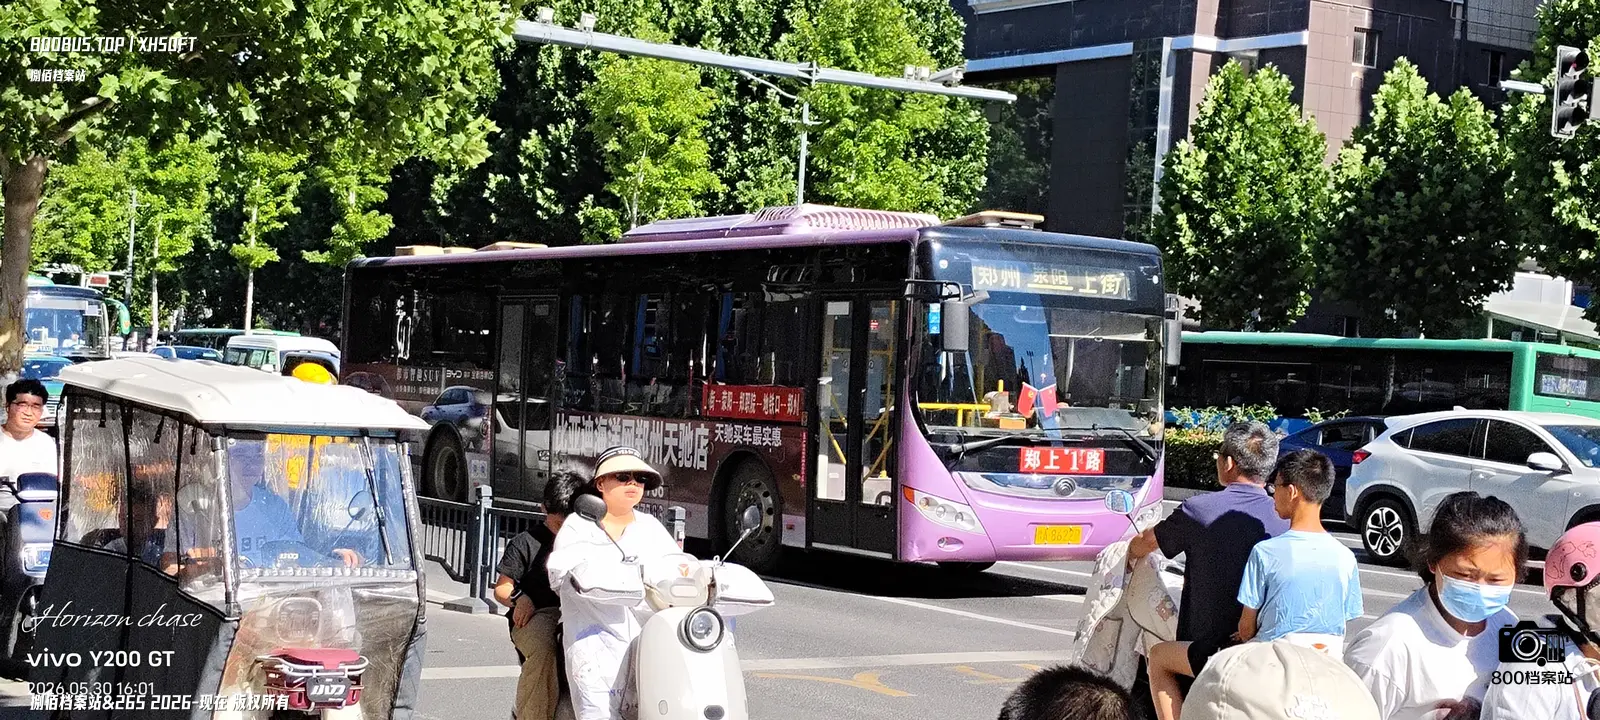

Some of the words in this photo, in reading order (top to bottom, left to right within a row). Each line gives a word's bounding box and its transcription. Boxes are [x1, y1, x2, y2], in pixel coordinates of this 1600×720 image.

[978, 266, 1020, 288] 郑州
[1079, 272, 1122, 295] 上街
[446, 369, 462, 379] BYD
[714, 423, 782, 447] 天驰买车最实惠
